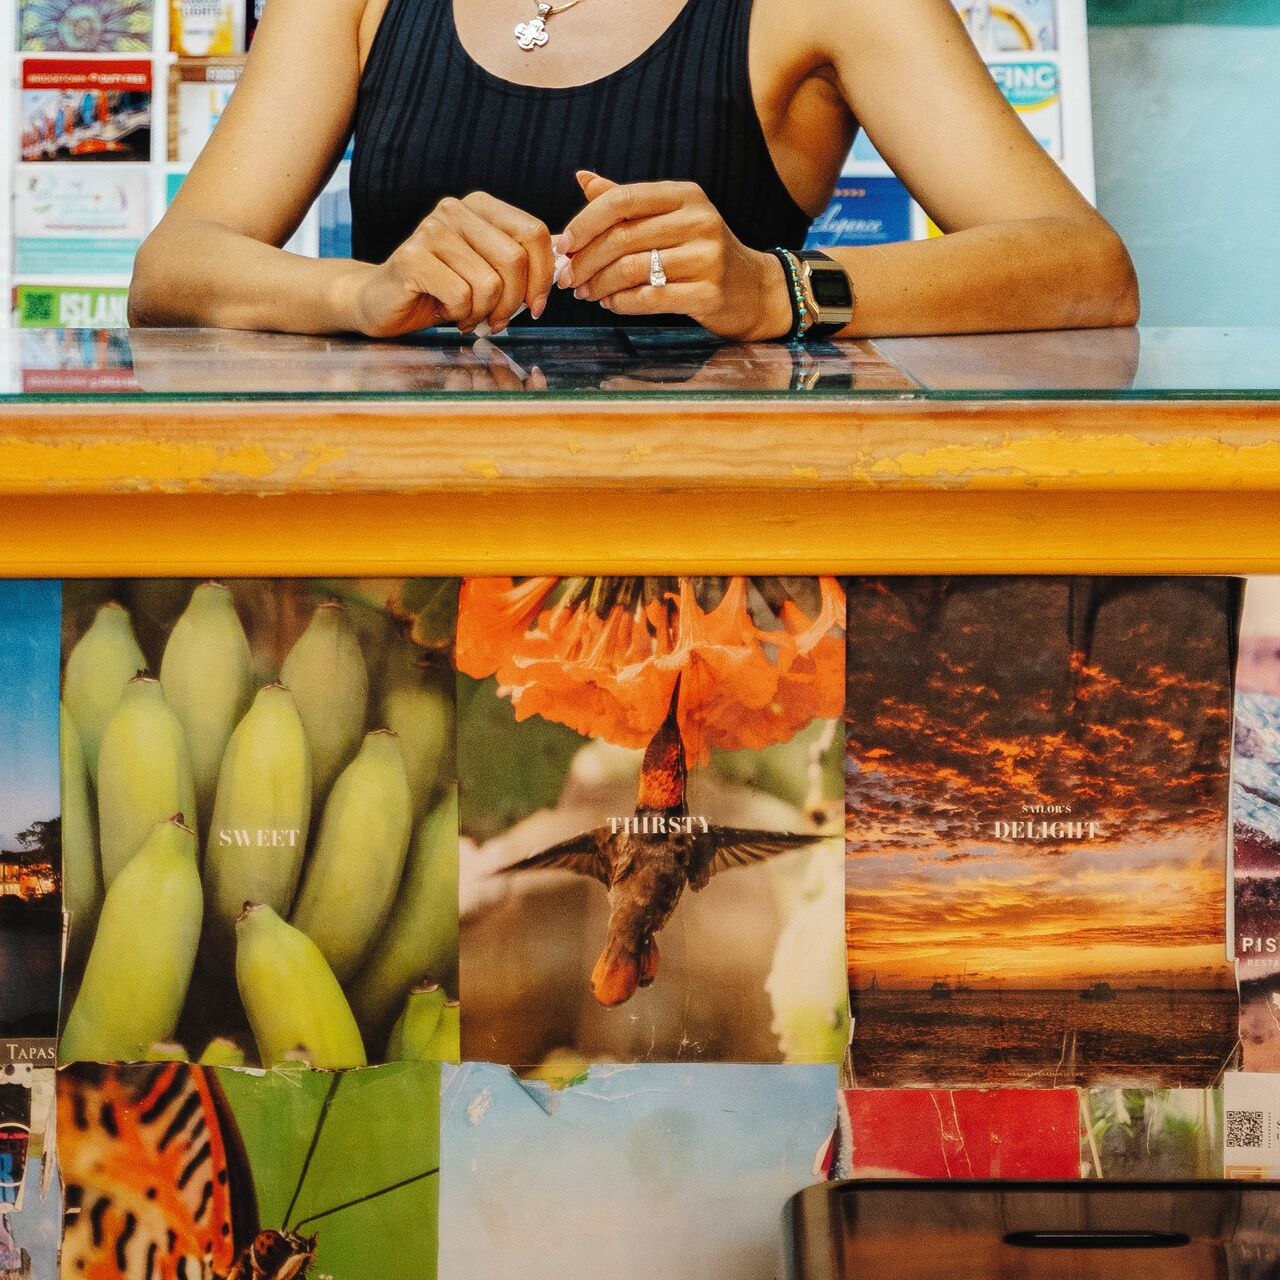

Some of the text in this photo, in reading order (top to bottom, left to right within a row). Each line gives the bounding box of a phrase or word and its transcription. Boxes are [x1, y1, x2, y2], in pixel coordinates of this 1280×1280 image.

[1021, 804, 1072, 813] SAILOR'S
[606, 816, 710, 834] THIRSTY
[994, 821, 1100, 839] DELIGHT
[219, 829, 300, 847] SWEET
